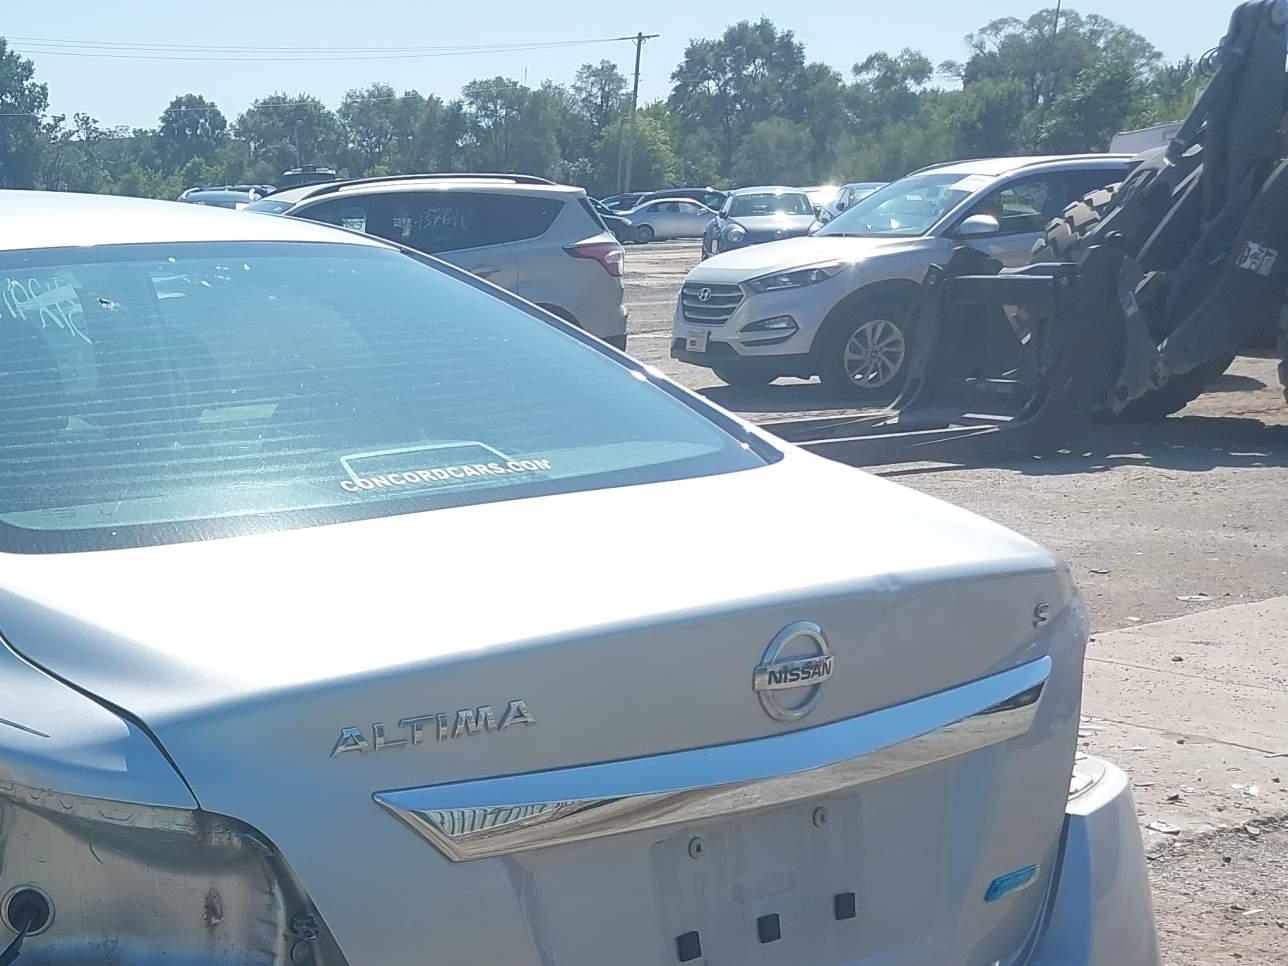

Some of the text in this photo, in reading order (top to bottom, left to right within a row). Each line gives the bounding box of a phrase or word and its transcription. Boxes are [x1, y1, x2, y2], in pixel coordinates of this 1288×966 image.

[1032, 602, 1049, 628] S
[767, 660, 833, 686] NISSAN
[329, 698, 537, 758] ALTIMA
